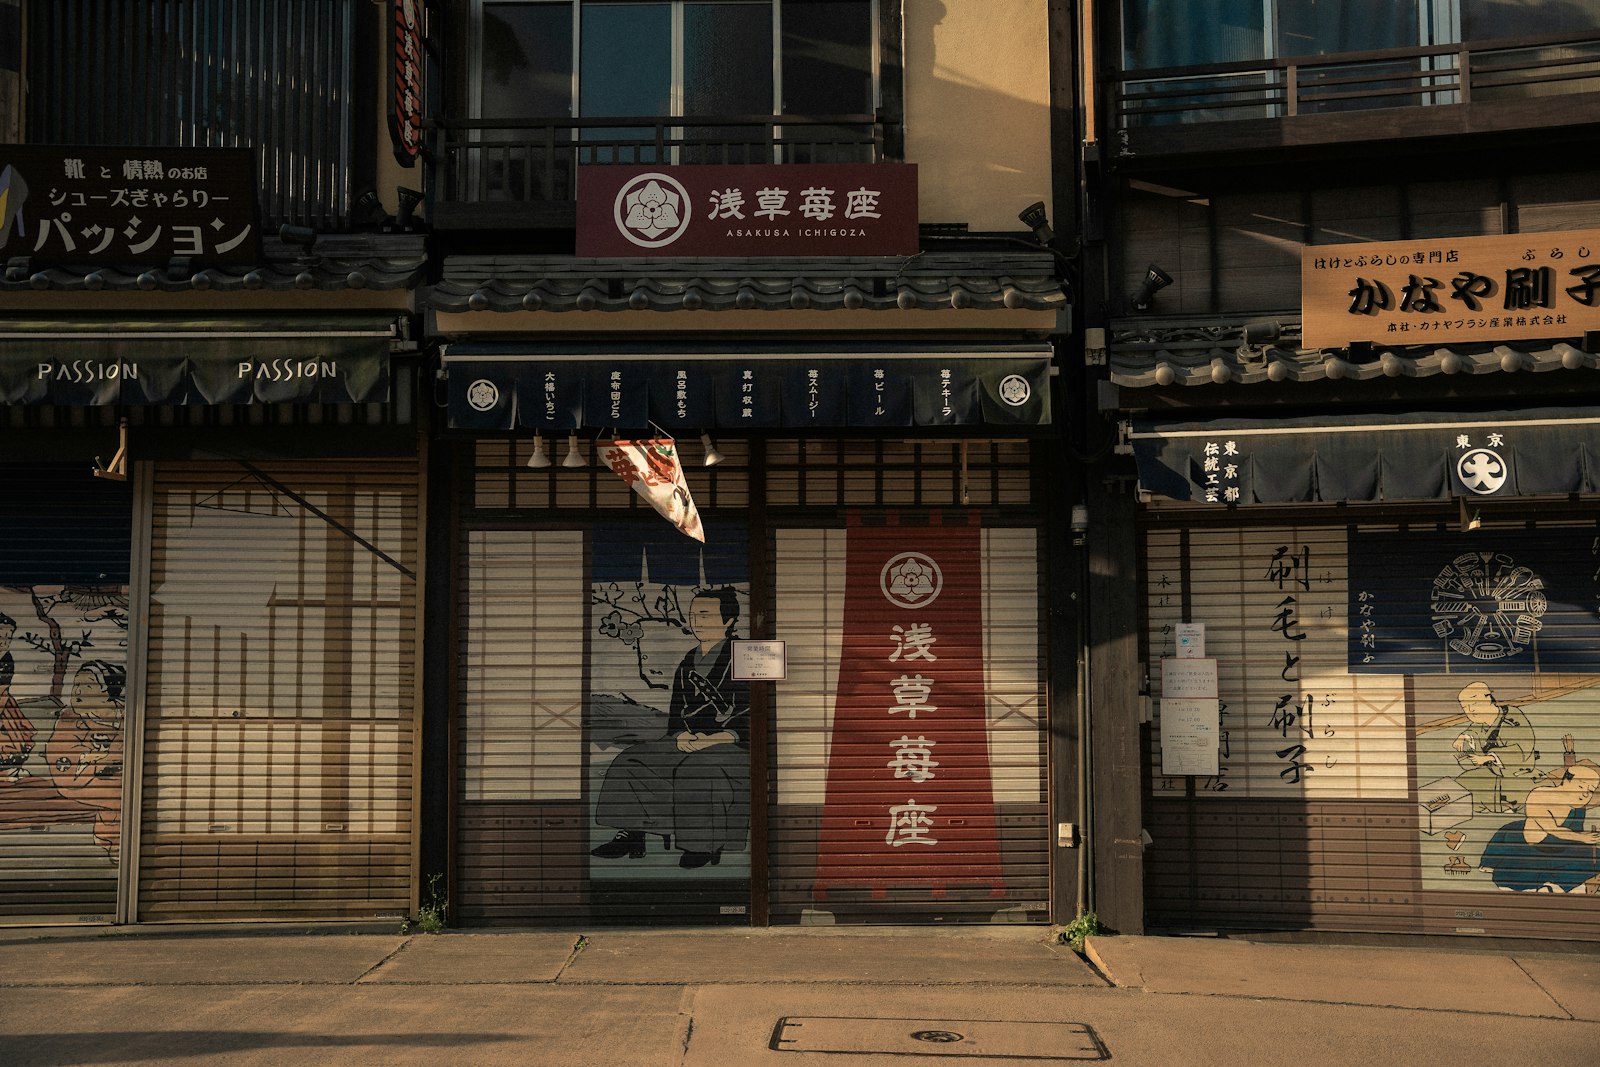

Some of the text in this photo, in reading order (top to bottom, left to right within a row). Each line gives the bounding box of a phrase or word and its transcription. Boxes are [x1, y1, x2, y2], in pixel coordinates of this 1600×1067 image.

[48, 187, 230, 208] シューズぎゃらりー
[707, 186, 882, 222] 浅草苺座
[33, 212, 252, 256] パッション
[726, 229, 867, 238] ASAKUSA ICHIGOZA
[1521, 246, 1591, 261] ぶらし
[1314, 249, 1459, 270] はけとぶらしの専門店
[1348, 264, 1600, 316] かなや刷子
[38, 359, 139, 383] PASSION
[238, 358, 337, 382] PASSION
[808, 369, 819, 418] 苺スムージー
[873, 369, 885, 416] 苺ビール
[940, 369, 952, 416] 苺テキーラ
[544, 371, 556, 420] 大福いちご
[610, 370, 621, 419] 座布団どら
[676, 370, 687, 418] 風呂敷もち
[1455, 433, 1504, 449] 東京
[1203, 442, 1220, 502] 伝統工芸
[1223, 441, 1240, 502] 東京都
[1264, 545, 1315, 784] 刷毛と刷子
[886, 622, 940, 847] 浅草苺座
[1321, 692, 1338, 769] ぶらし
